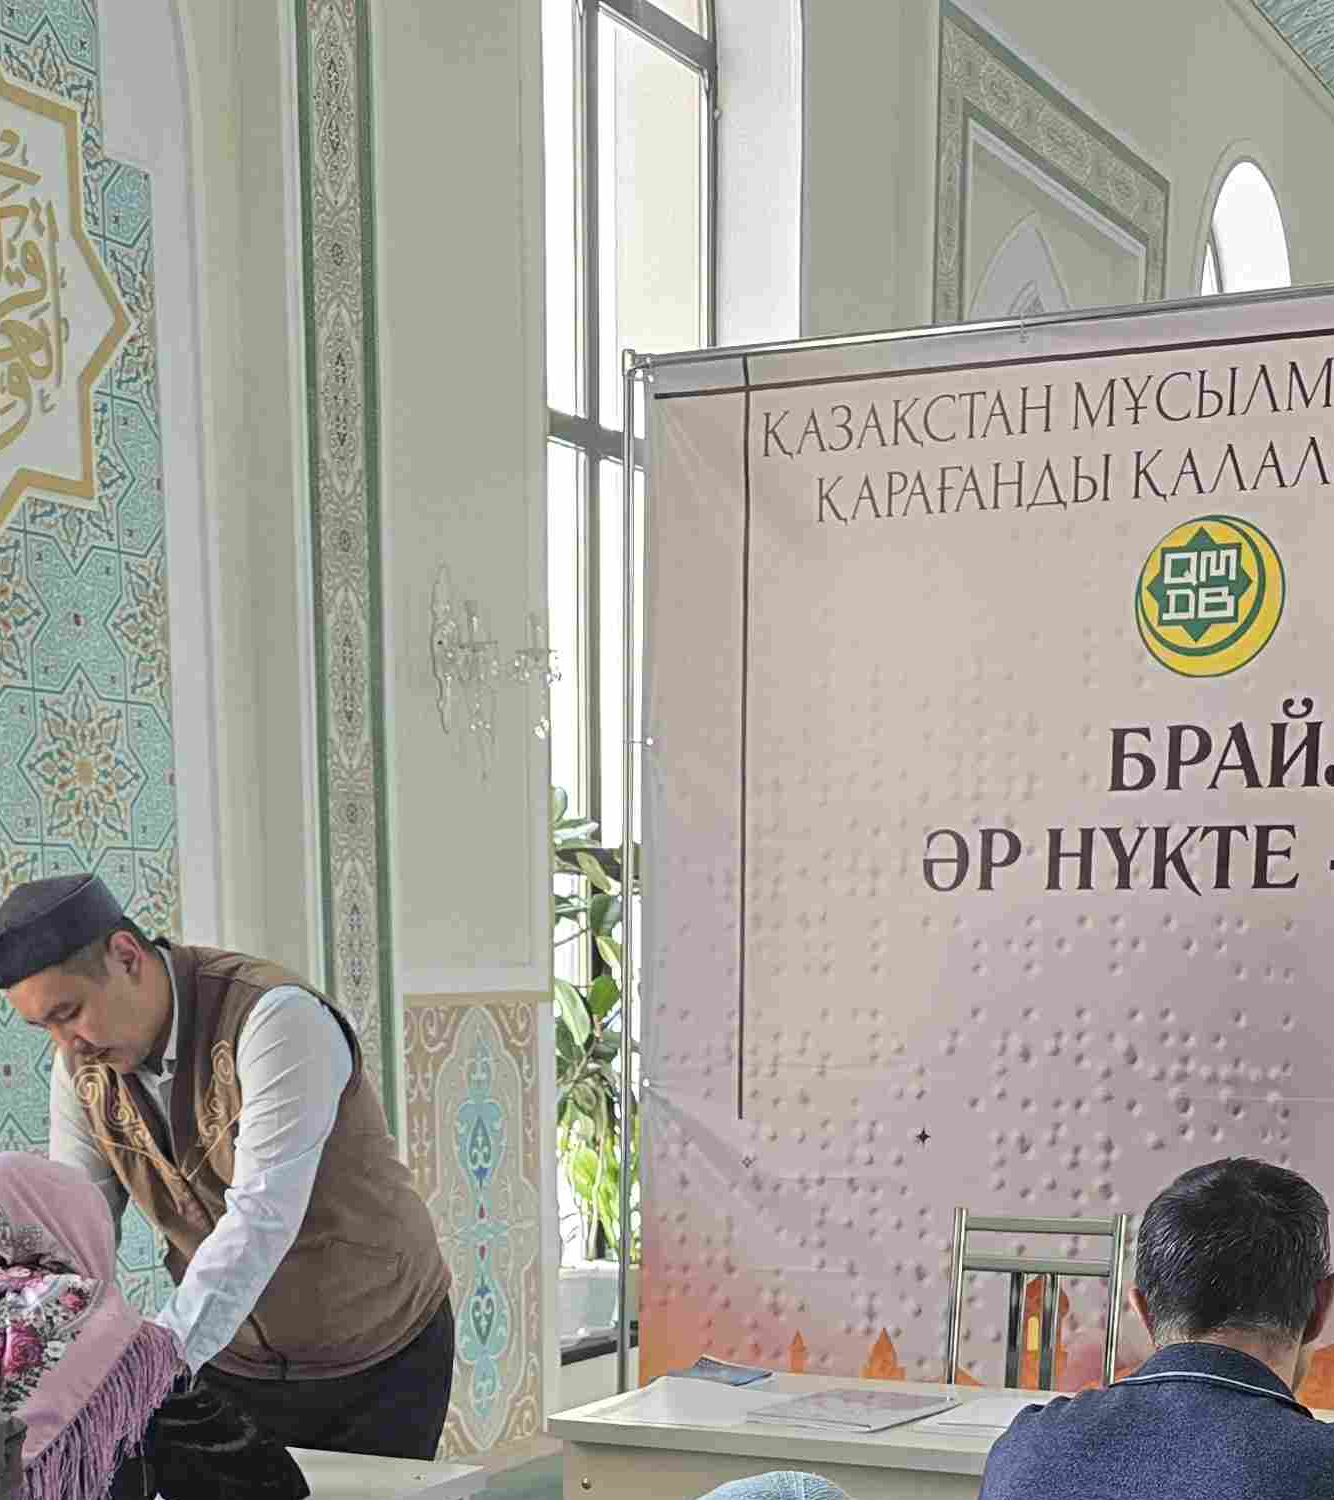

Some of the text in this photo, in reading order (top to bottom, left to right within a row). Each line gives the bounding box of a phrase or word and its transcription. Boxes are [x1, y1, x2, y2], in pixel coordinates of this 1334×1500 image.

[762, 383, 1053, 460] ҚАЗАҚСТАН
[816, 454, 1113, 527] ҚАРАҒАНДЫ
[922, 827, 1023, 893] ӘР
[1045, 823, 1301, 897] НҮКТЕ
